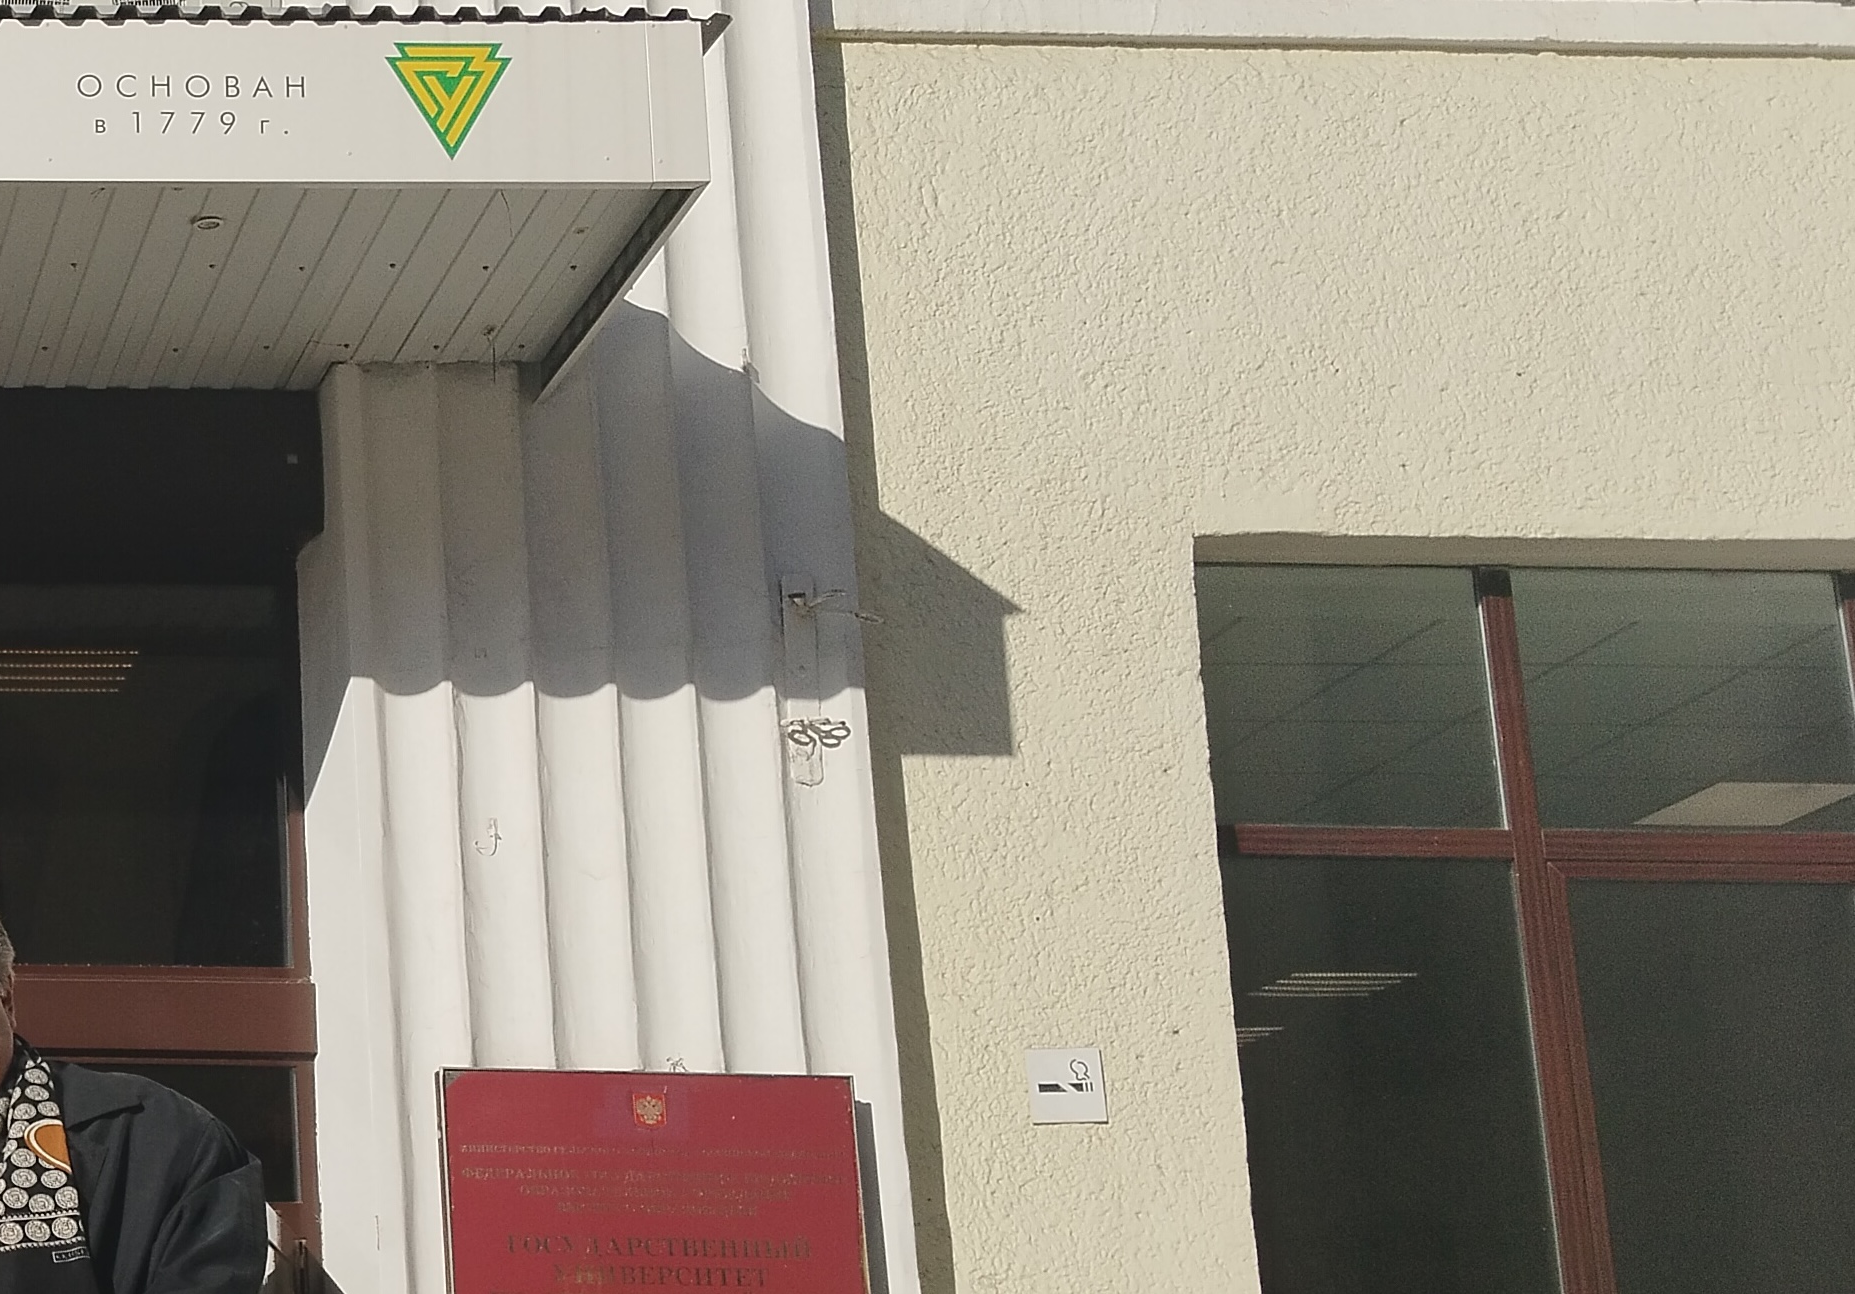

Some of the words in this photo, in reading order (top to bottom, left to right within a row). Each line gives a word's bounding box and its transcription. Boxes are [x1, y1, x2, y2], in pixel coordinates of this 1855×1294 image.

[76, 74, 307, 99] ОСНОВАН
[94, 118, 107, 134] в
[131, 111, 237, 135] 1779
[259, 118, 289, 135] г.
[506, 1234, 812, 1259] ГОСУДАРСТВЕННЫЙ
[553, 1264, 770, 1287] УНИВЕРСИТЕТ
